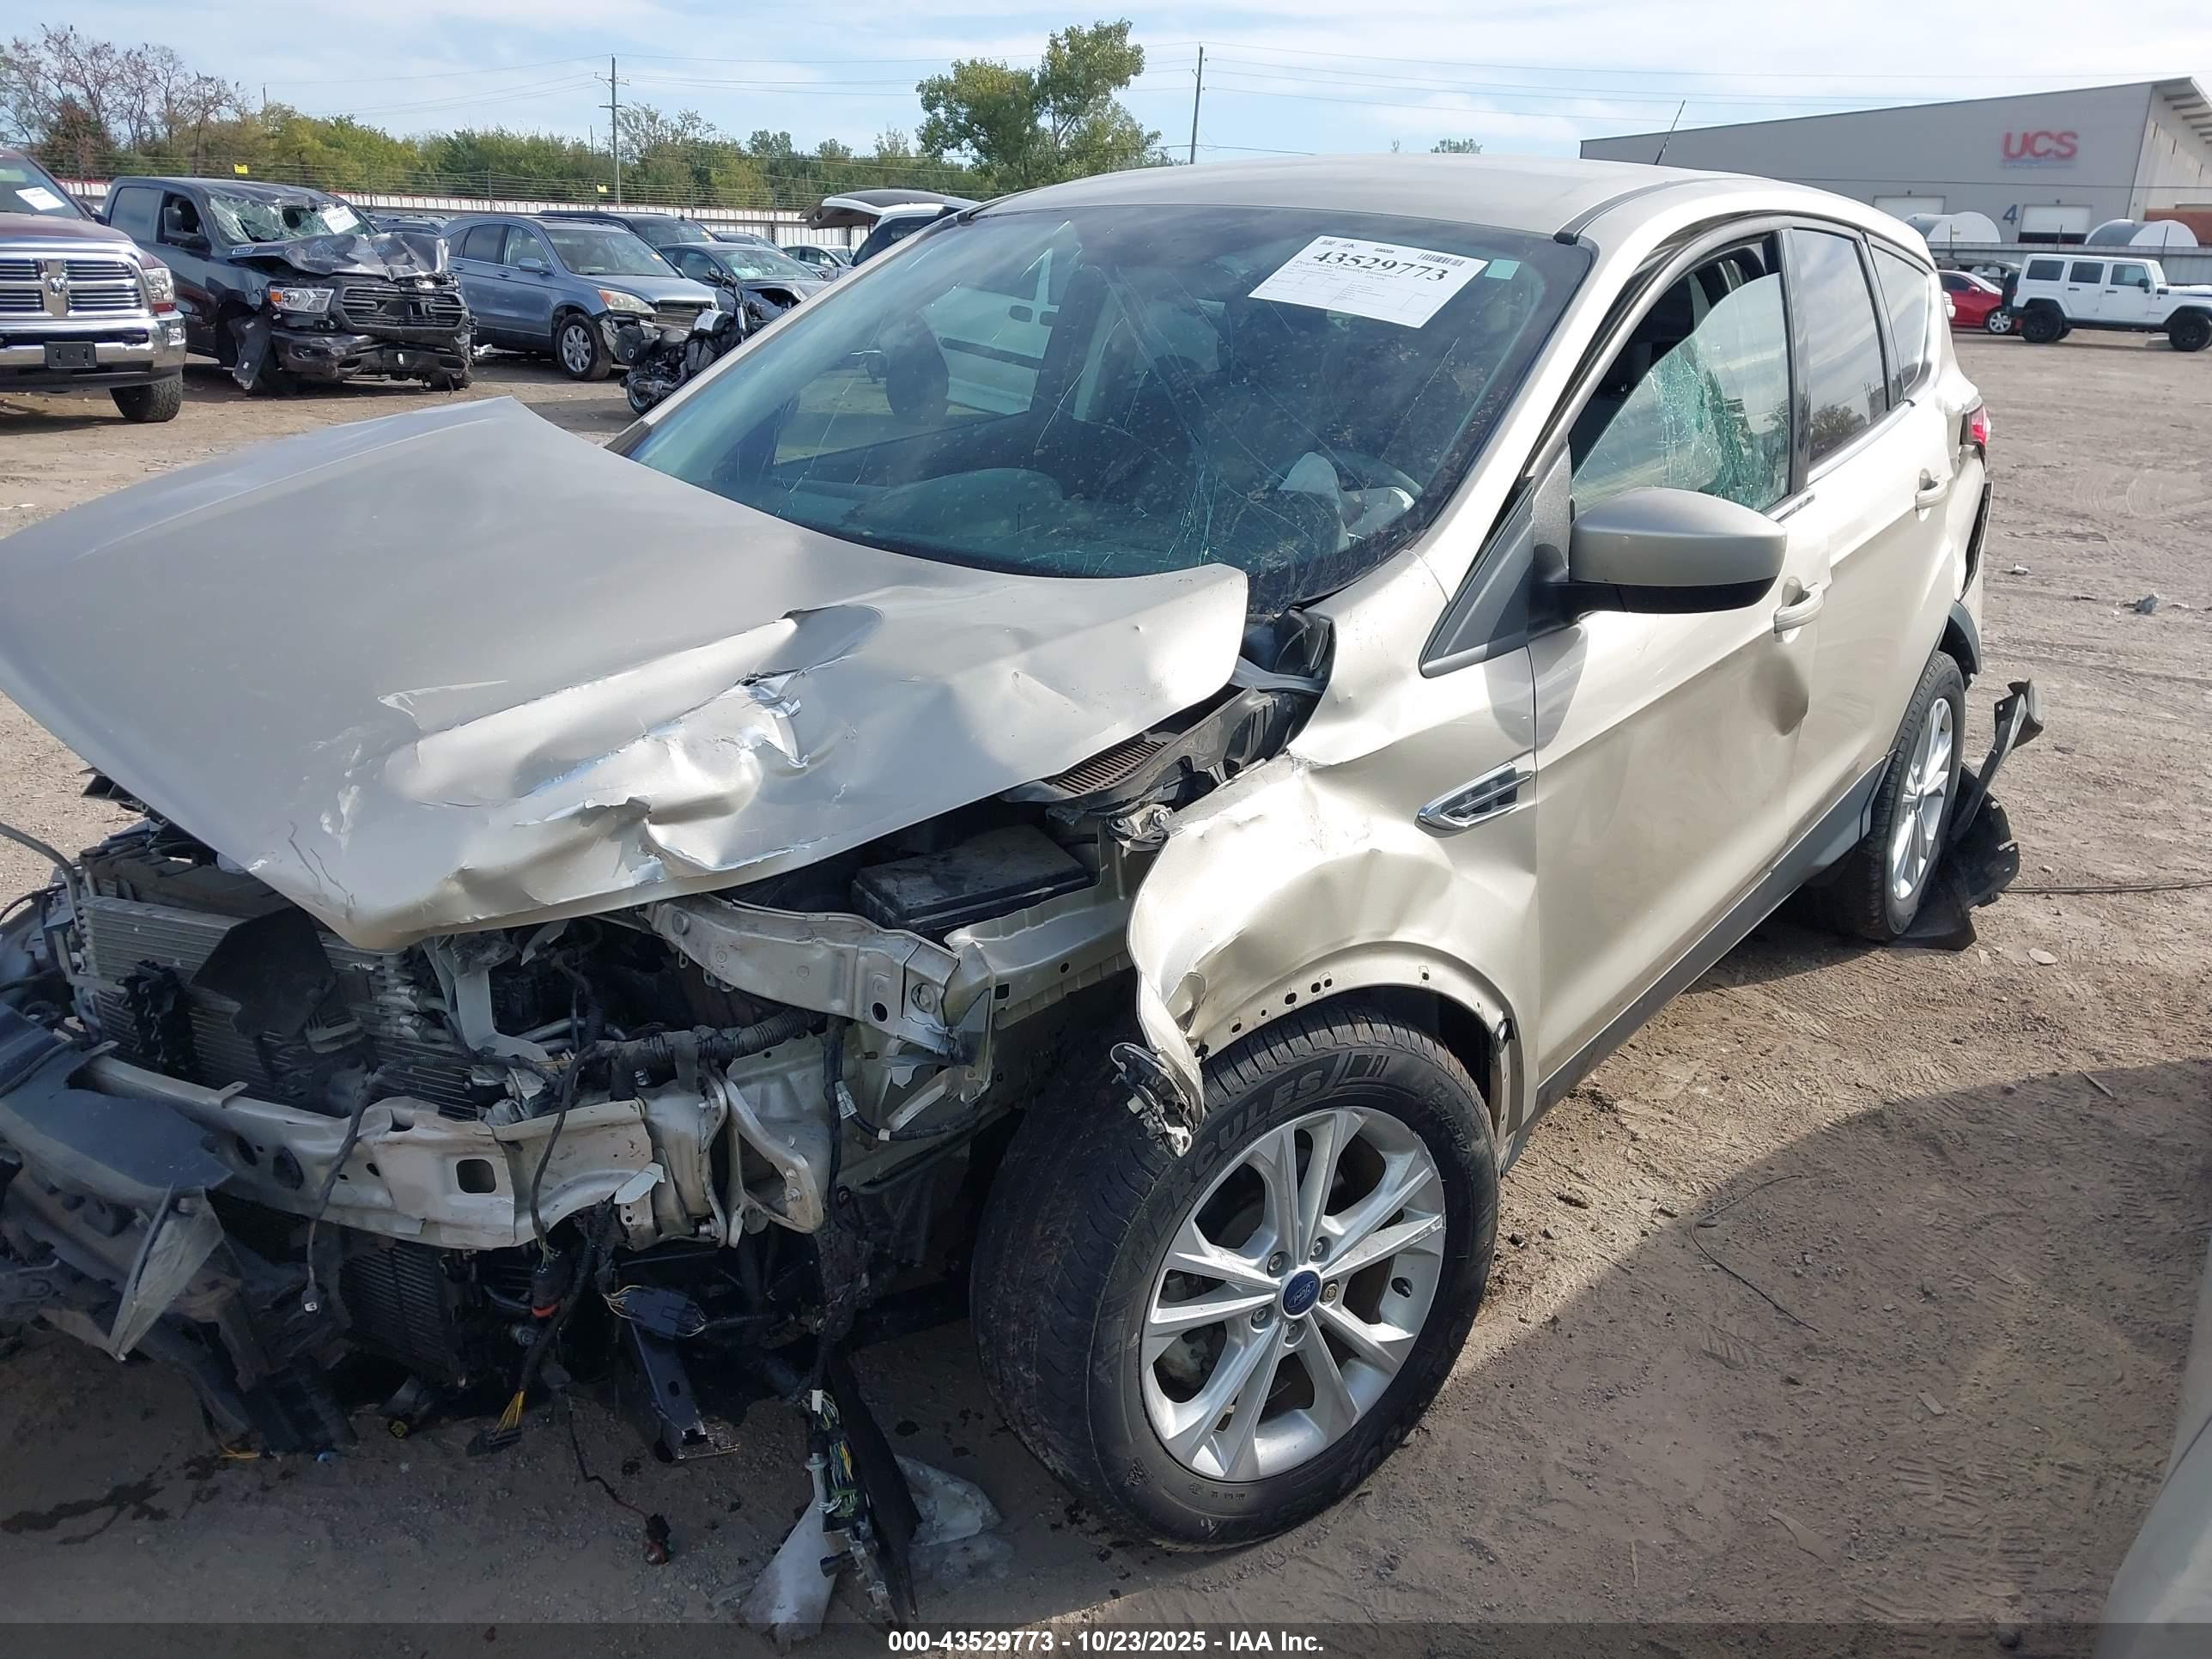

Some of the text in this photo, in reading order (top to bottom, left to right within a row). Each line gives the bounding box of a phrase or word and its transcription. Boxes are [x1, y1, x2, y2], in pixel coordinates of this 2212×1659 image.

[2002, 131, 2078, 159] UCS
[2002, 204, 2018, 226] 4
[1312, 250, 1449, 282] 43529773
